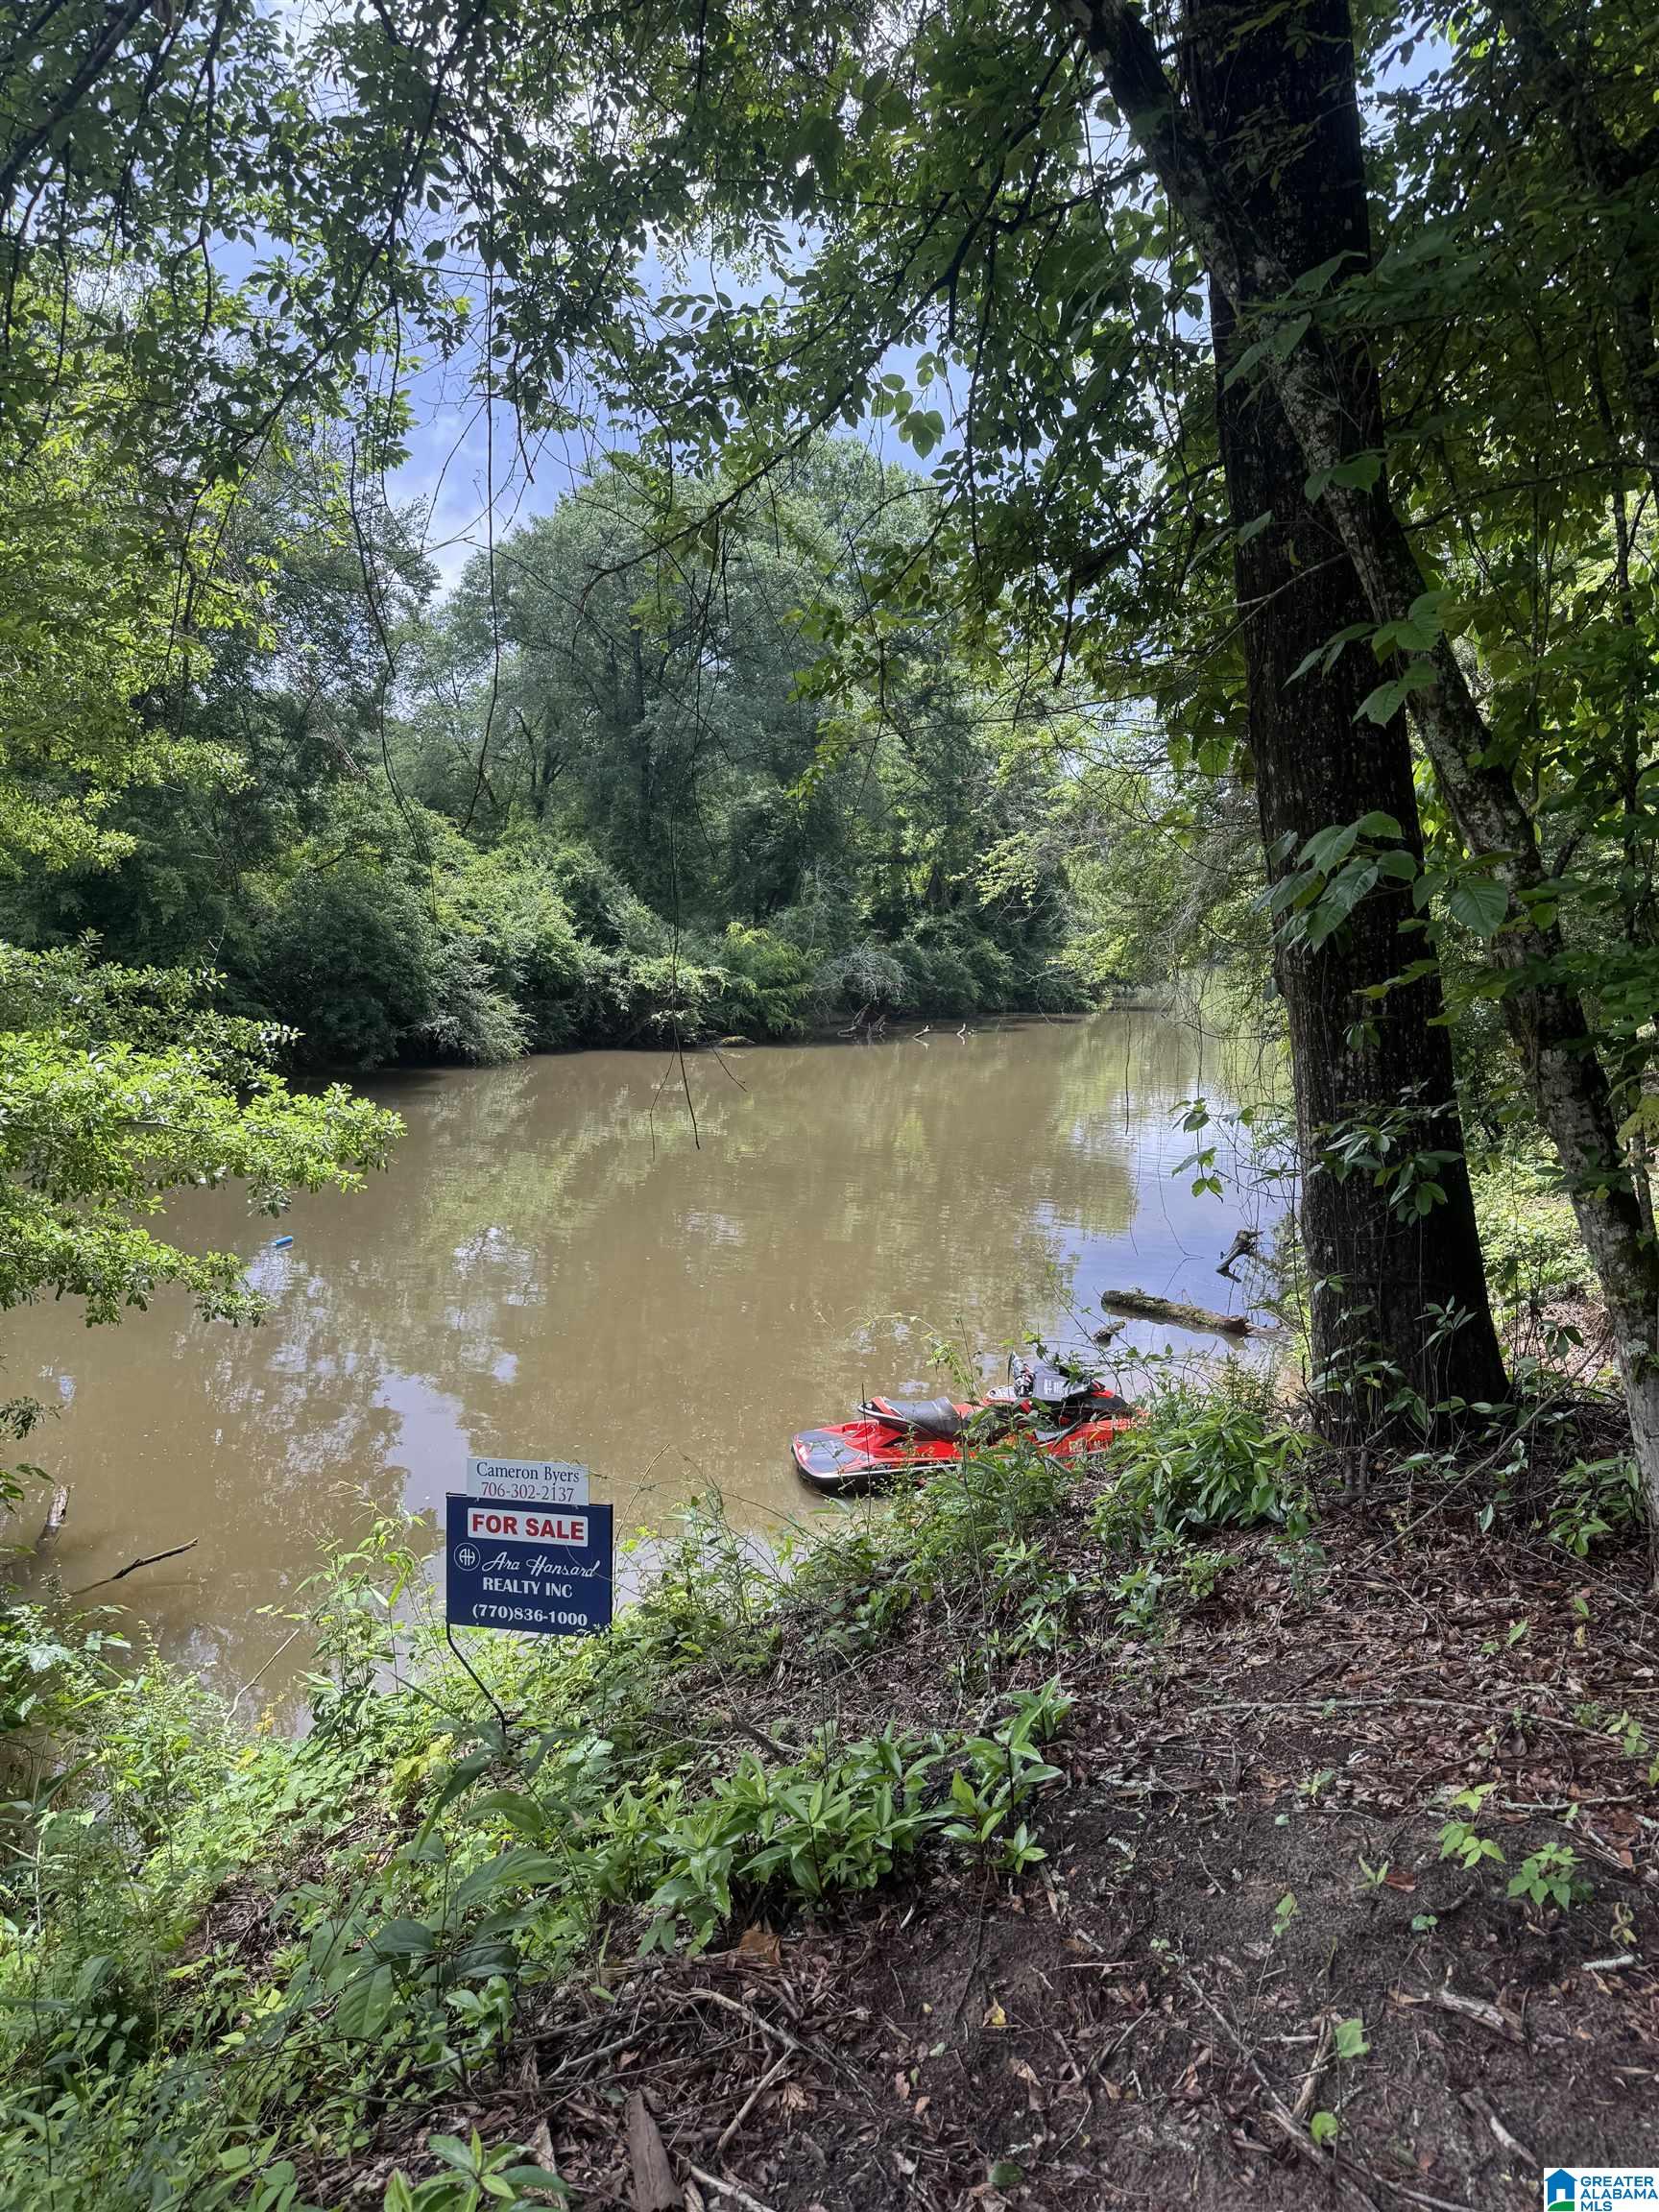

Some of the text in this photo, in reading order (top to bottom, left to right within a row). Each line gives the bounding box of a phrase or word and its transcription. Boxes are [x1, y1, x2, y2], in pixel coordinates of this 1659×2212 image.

[476, 1461, 580, 1485] Cameron Byers
[481, 1481, 574, 1503] 706-302-2137
[472, 1513, 585, 1541] FOR SALE
[482, 1577, 573, 1599] REALTY INC
[472, 1603, 589, 1626] (770)836-1000
